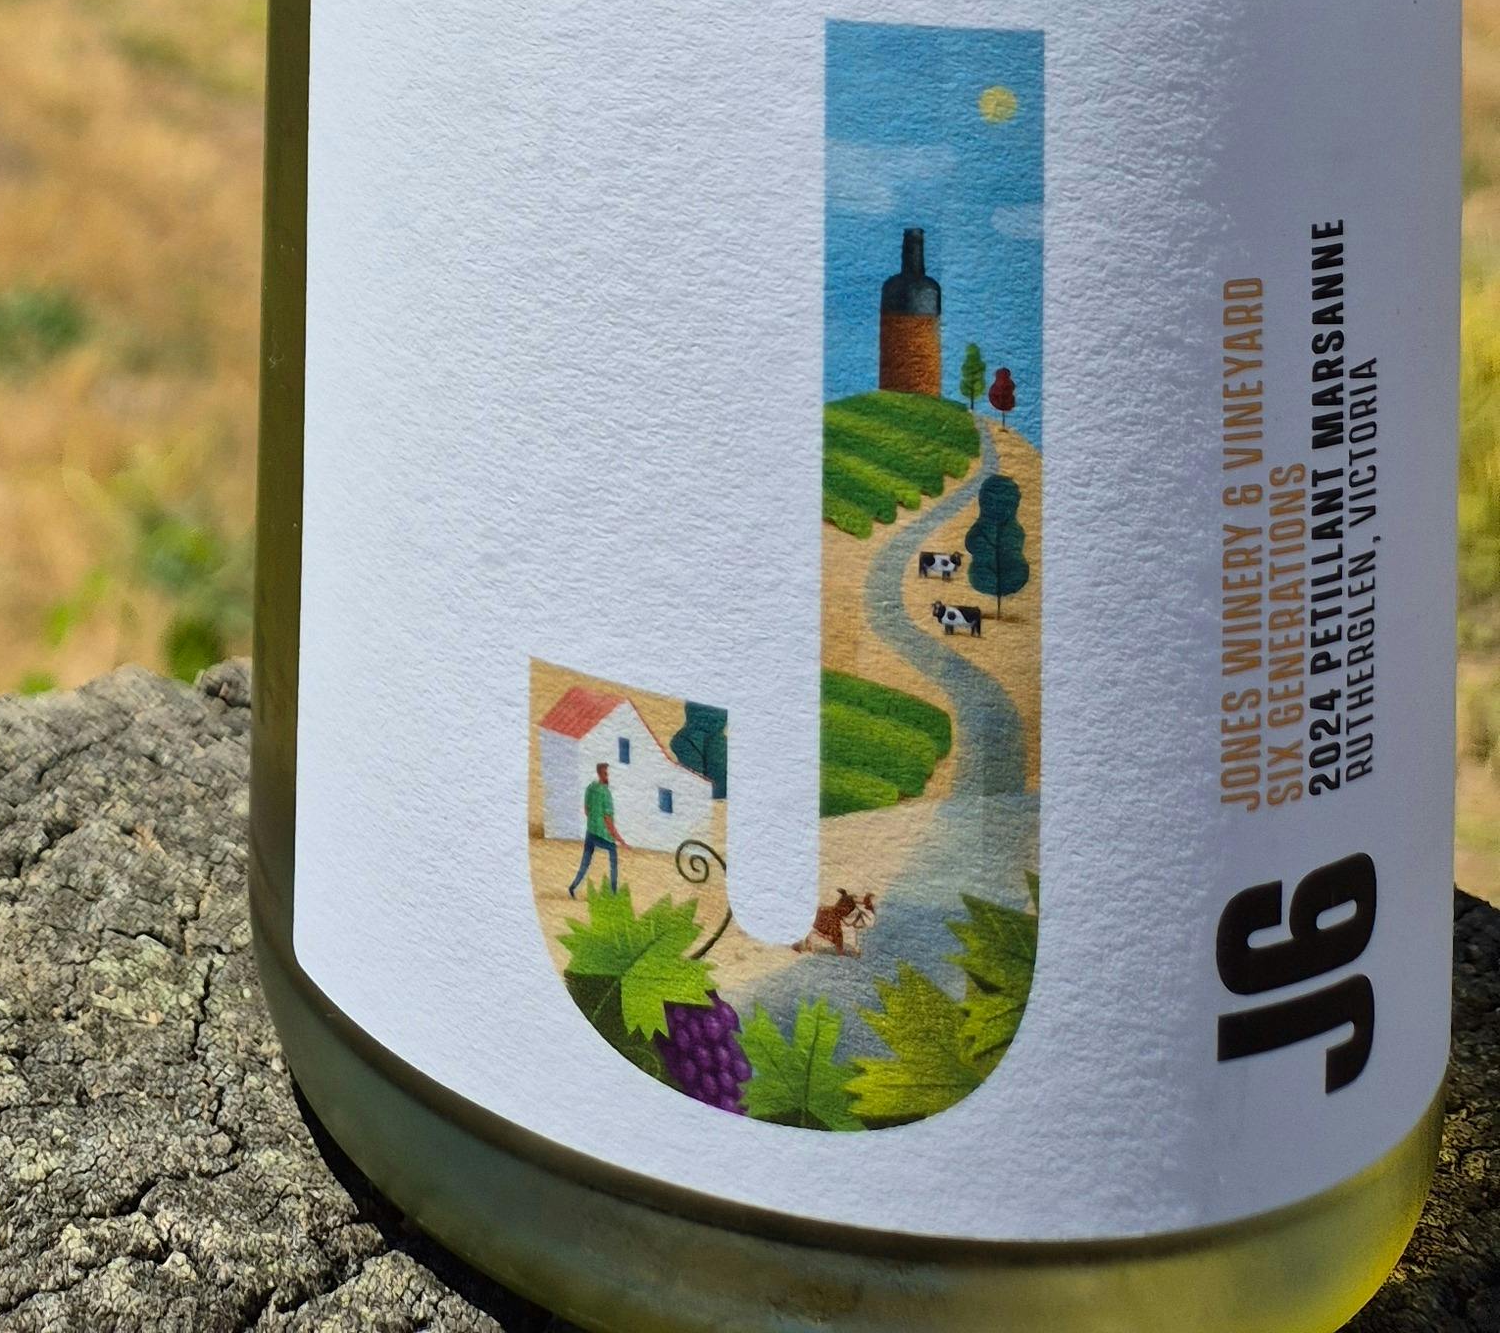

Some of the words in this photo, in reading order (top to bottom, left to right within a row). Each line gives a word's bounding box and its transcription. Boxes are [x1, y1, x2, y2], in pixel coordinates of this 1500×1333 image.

[1222, 276, 1264, 471] VINEYARD
[1311, 219, 1345, 450] MARSANNE
[1222, 482, 1264, 507] &
[1348, 357, 1378, 528] VICTORIA
[1221, 523, 1264, 677] WINERY
[1267, 462, 1307, 729] GENERATIONS
[1309, 468, 1345, 675] PETILLANT
[1345, 534, 1382, 783] RUTHERGLEN,
[1220, 687, 1263, 813] JONES
[1266, 738, 1304, 807] SIX
[1308, 688, 1342, 796] 2024
[1215, 851, 1378, 1095] J6
